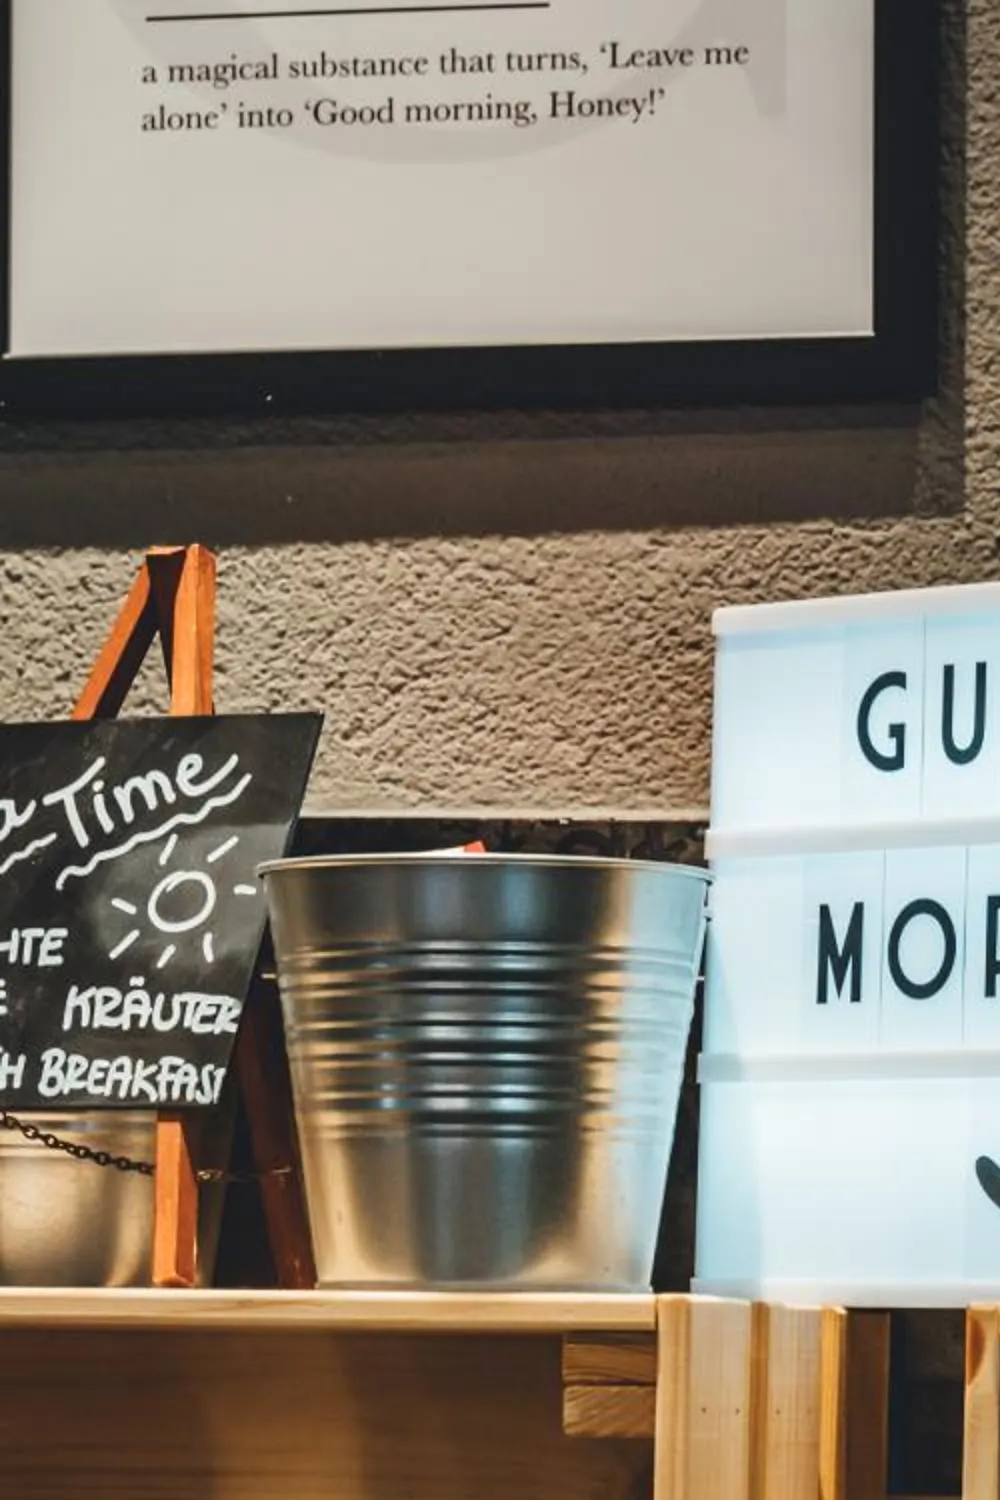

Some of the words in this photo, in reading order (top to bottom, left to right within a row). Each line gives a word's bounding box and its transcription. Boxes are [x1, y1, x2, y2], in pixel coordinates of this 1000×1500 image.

[141, 67, 158, 84] a
[168, 52, 279, 89] magical
[288, 51, 429, 79] substance
[439, 47, 496, 75] that
[505, 51, 589, 76] turns,
[703, 44, 751, 65] me
[237, 102, 294, 129] into
[404, 92, 538, 128] morning,
[42, 753, 240, 849] Time
[62, 975, 242, 1035] KRÄUTER
